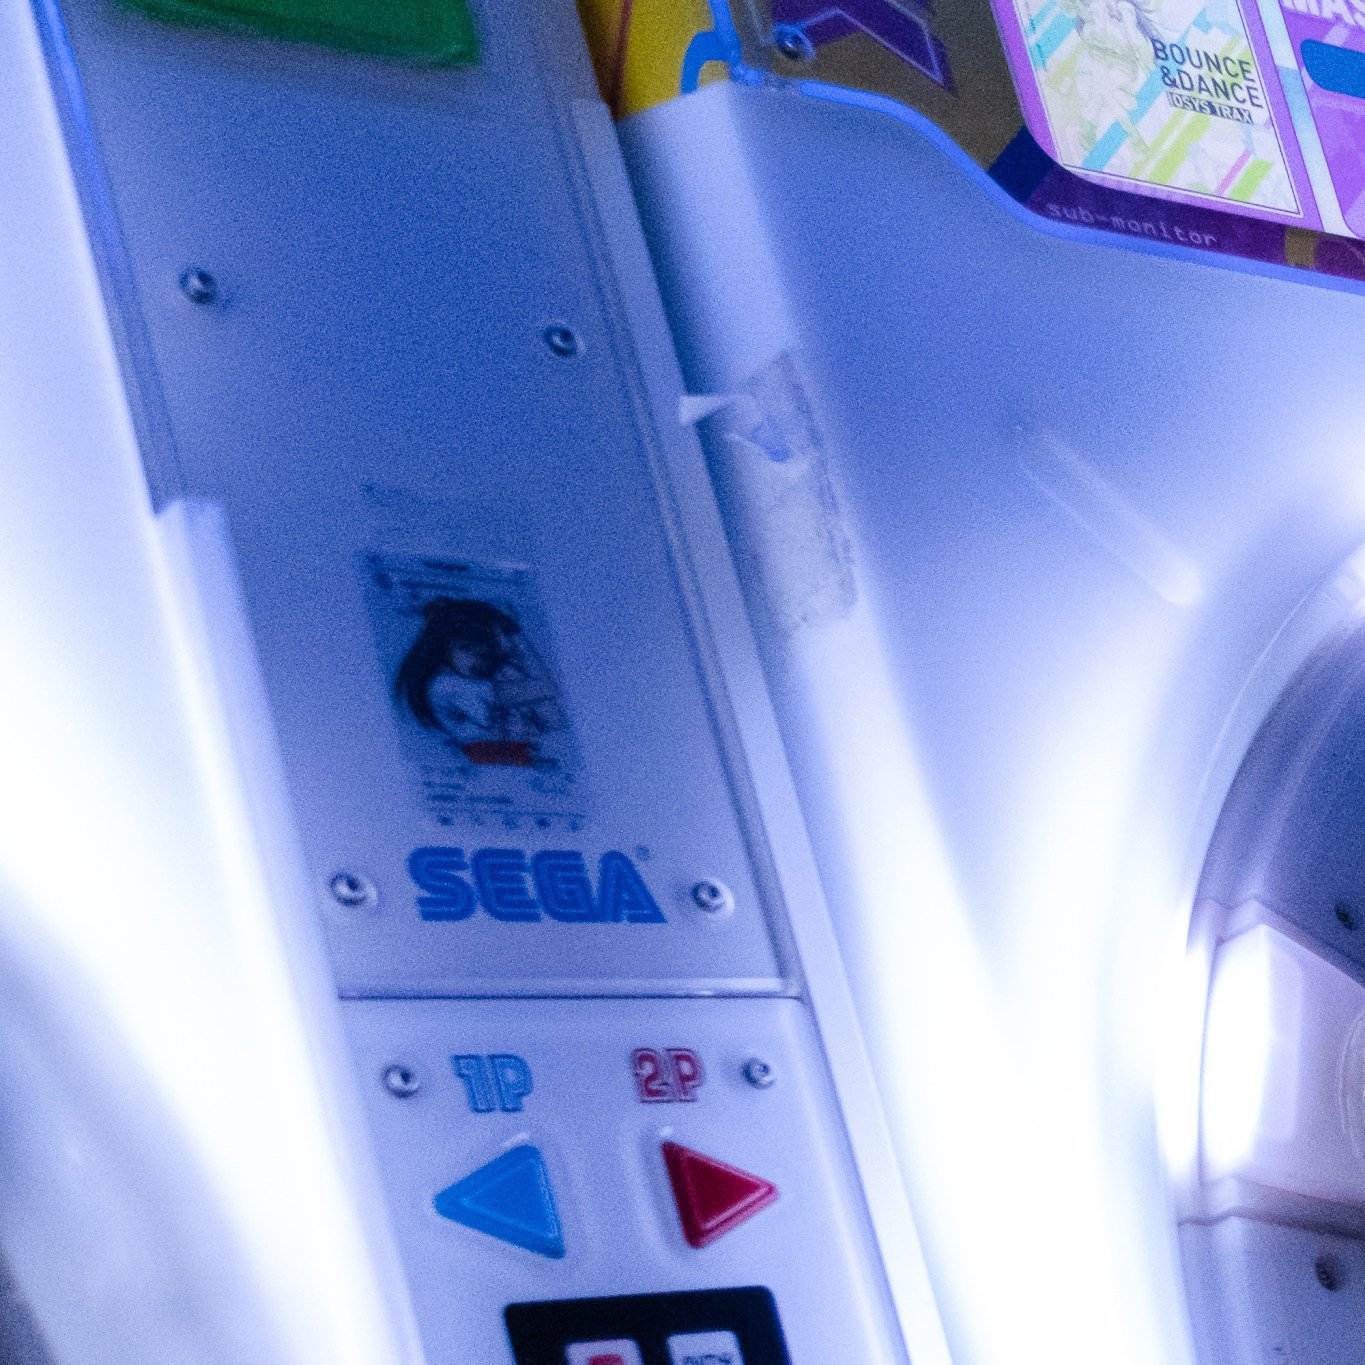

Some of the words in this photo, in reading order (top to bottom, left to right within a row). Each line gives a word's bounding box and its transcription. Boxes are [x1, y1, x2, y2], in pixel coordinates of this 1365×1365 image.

[1151, 38, 1256, 84] BOUNCE
[1160, 65, 1263, 110] &DANCE
[1048, 203, 1218, 247] sub-monitor
[408, 846, 667, 924] SEGA
[452, 1053, 533, 1114] 1P
[631, 1047, 706, 1105] 2P
